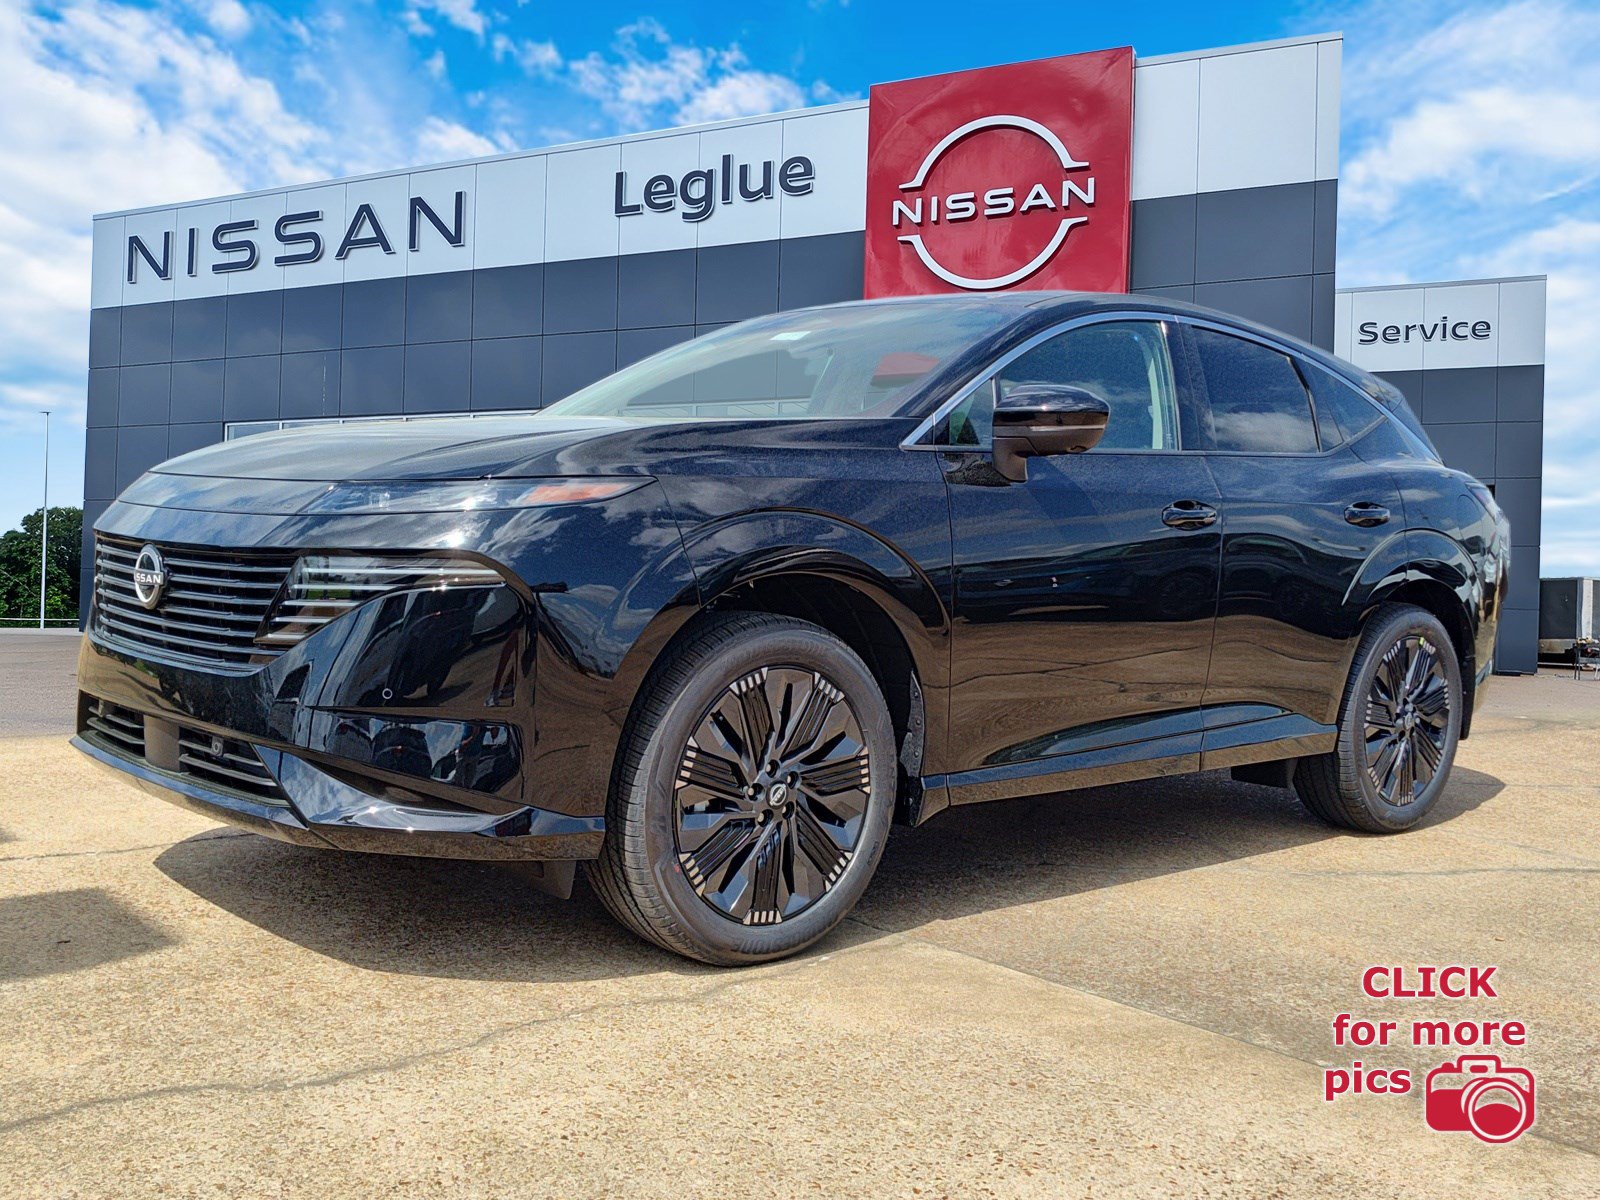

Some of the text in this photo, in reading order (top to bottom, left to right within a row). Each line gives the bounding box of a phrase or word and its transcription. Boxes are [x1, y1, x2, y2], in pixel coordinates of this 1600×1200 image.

[614, 153, 815, 222] Leglue
[892, 177, 1095, 226] NISSAN
[127, 190, 466, 284] NISSAN
[1358, 316, 1492, 345] Service
